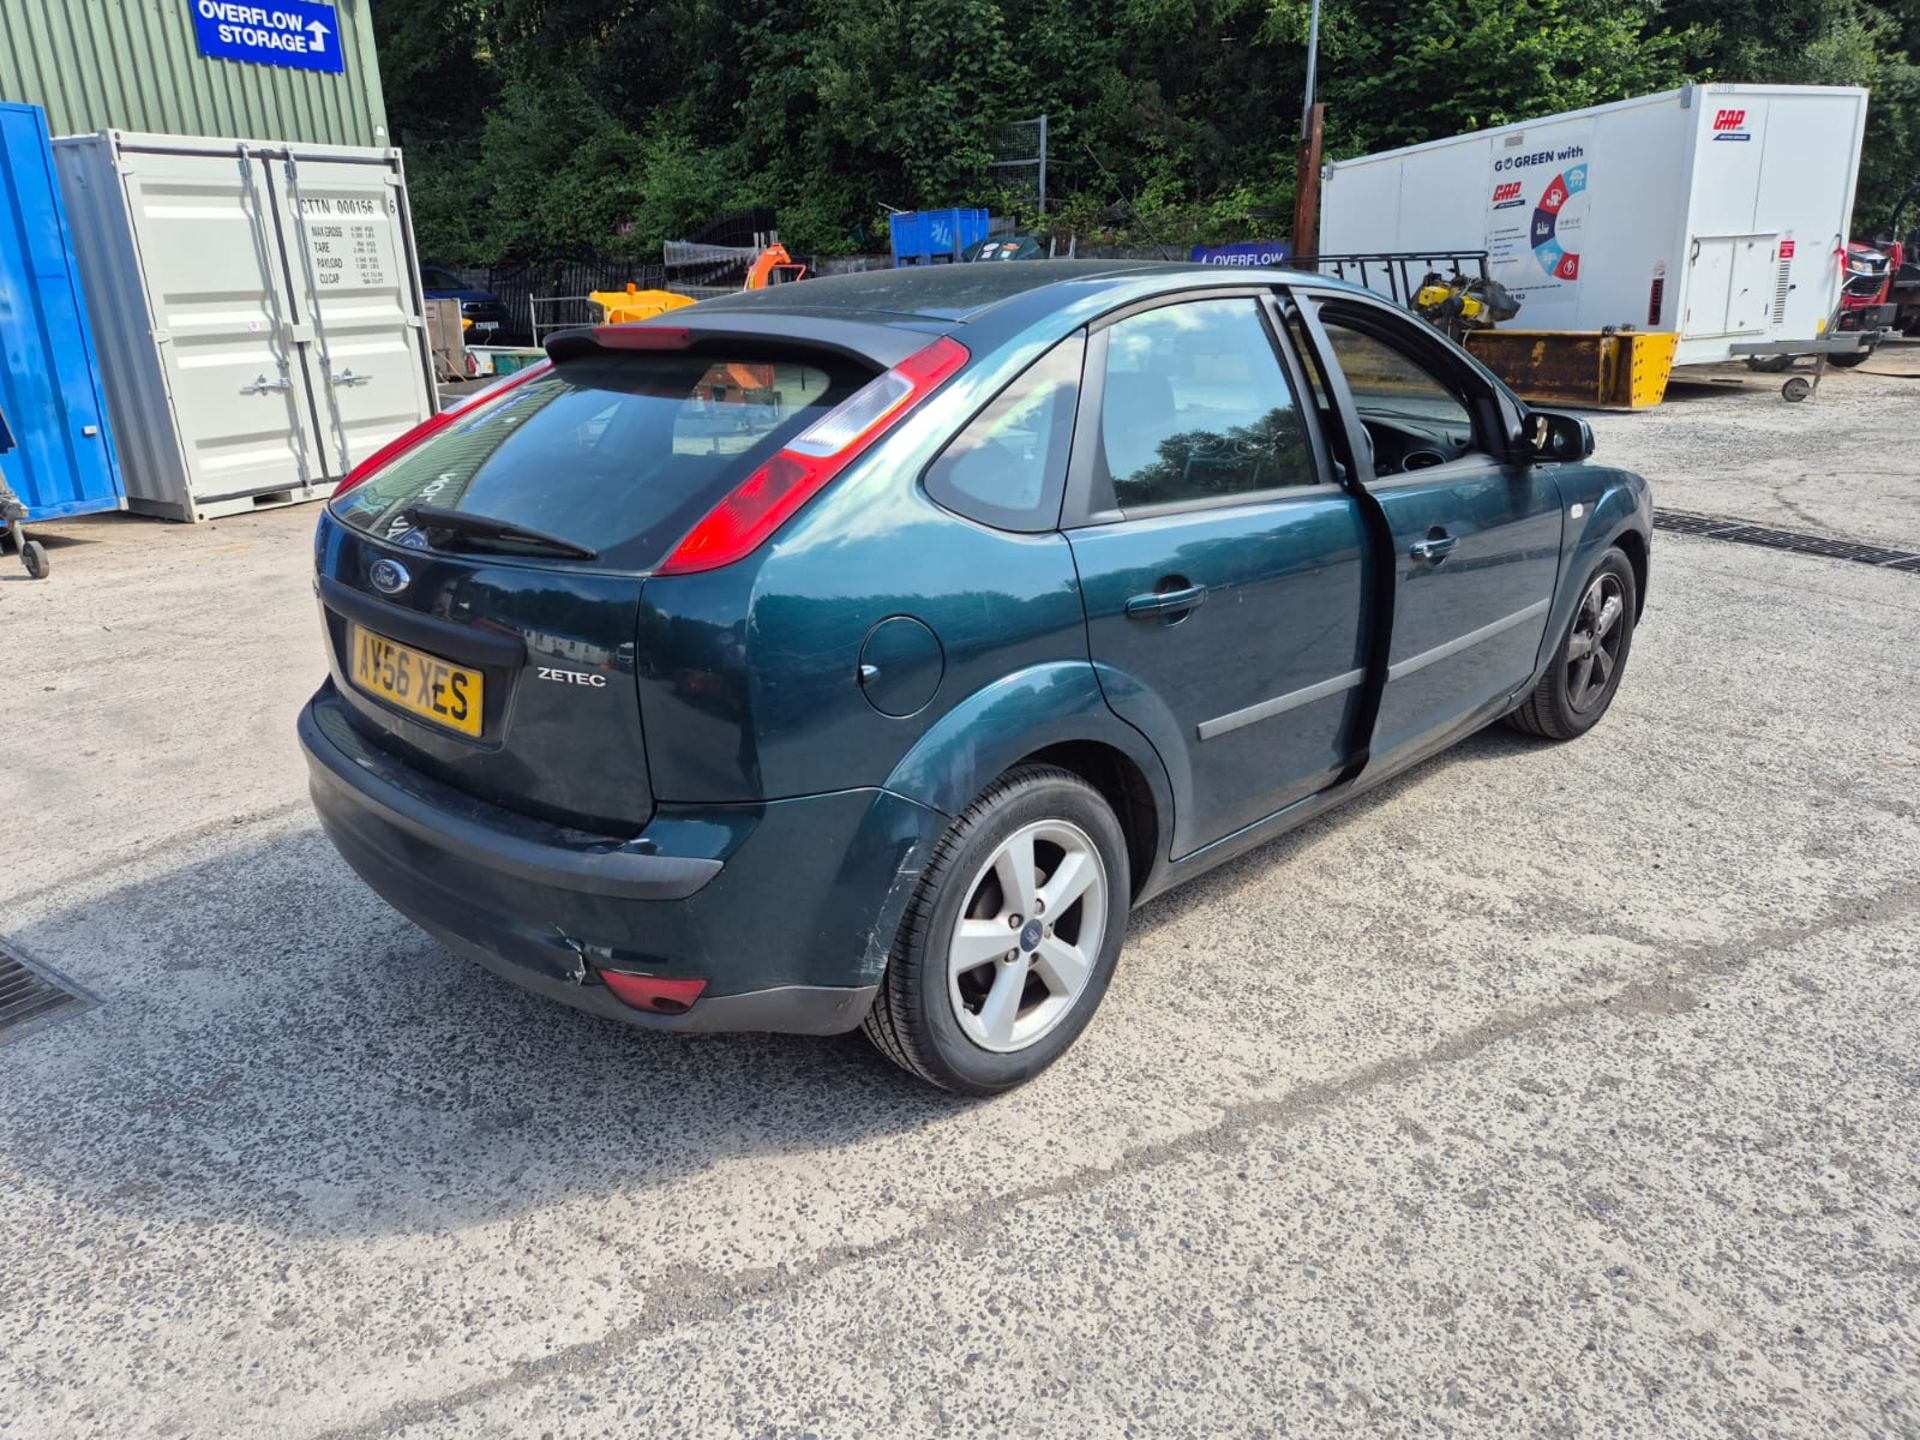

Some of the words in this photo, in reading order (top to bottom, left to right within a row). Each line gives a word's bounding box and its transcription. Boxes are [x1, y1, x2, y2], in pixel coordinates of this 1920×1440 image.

[199, 1, 302, 31] OVERFLOW
[218, 25, 308, 53] STORAGE
[1514, 150, 1554, 168] GREEN
[1557, 145, 1584, 160] with
[337, 200, 374, 214] 000156
[1213, 252, 1284, 266] OVERFLOW
[360, 633, 410, 698] AY56
[416, 657, 469, 721] XES
[537, 666, 606, 688] ZETEC
